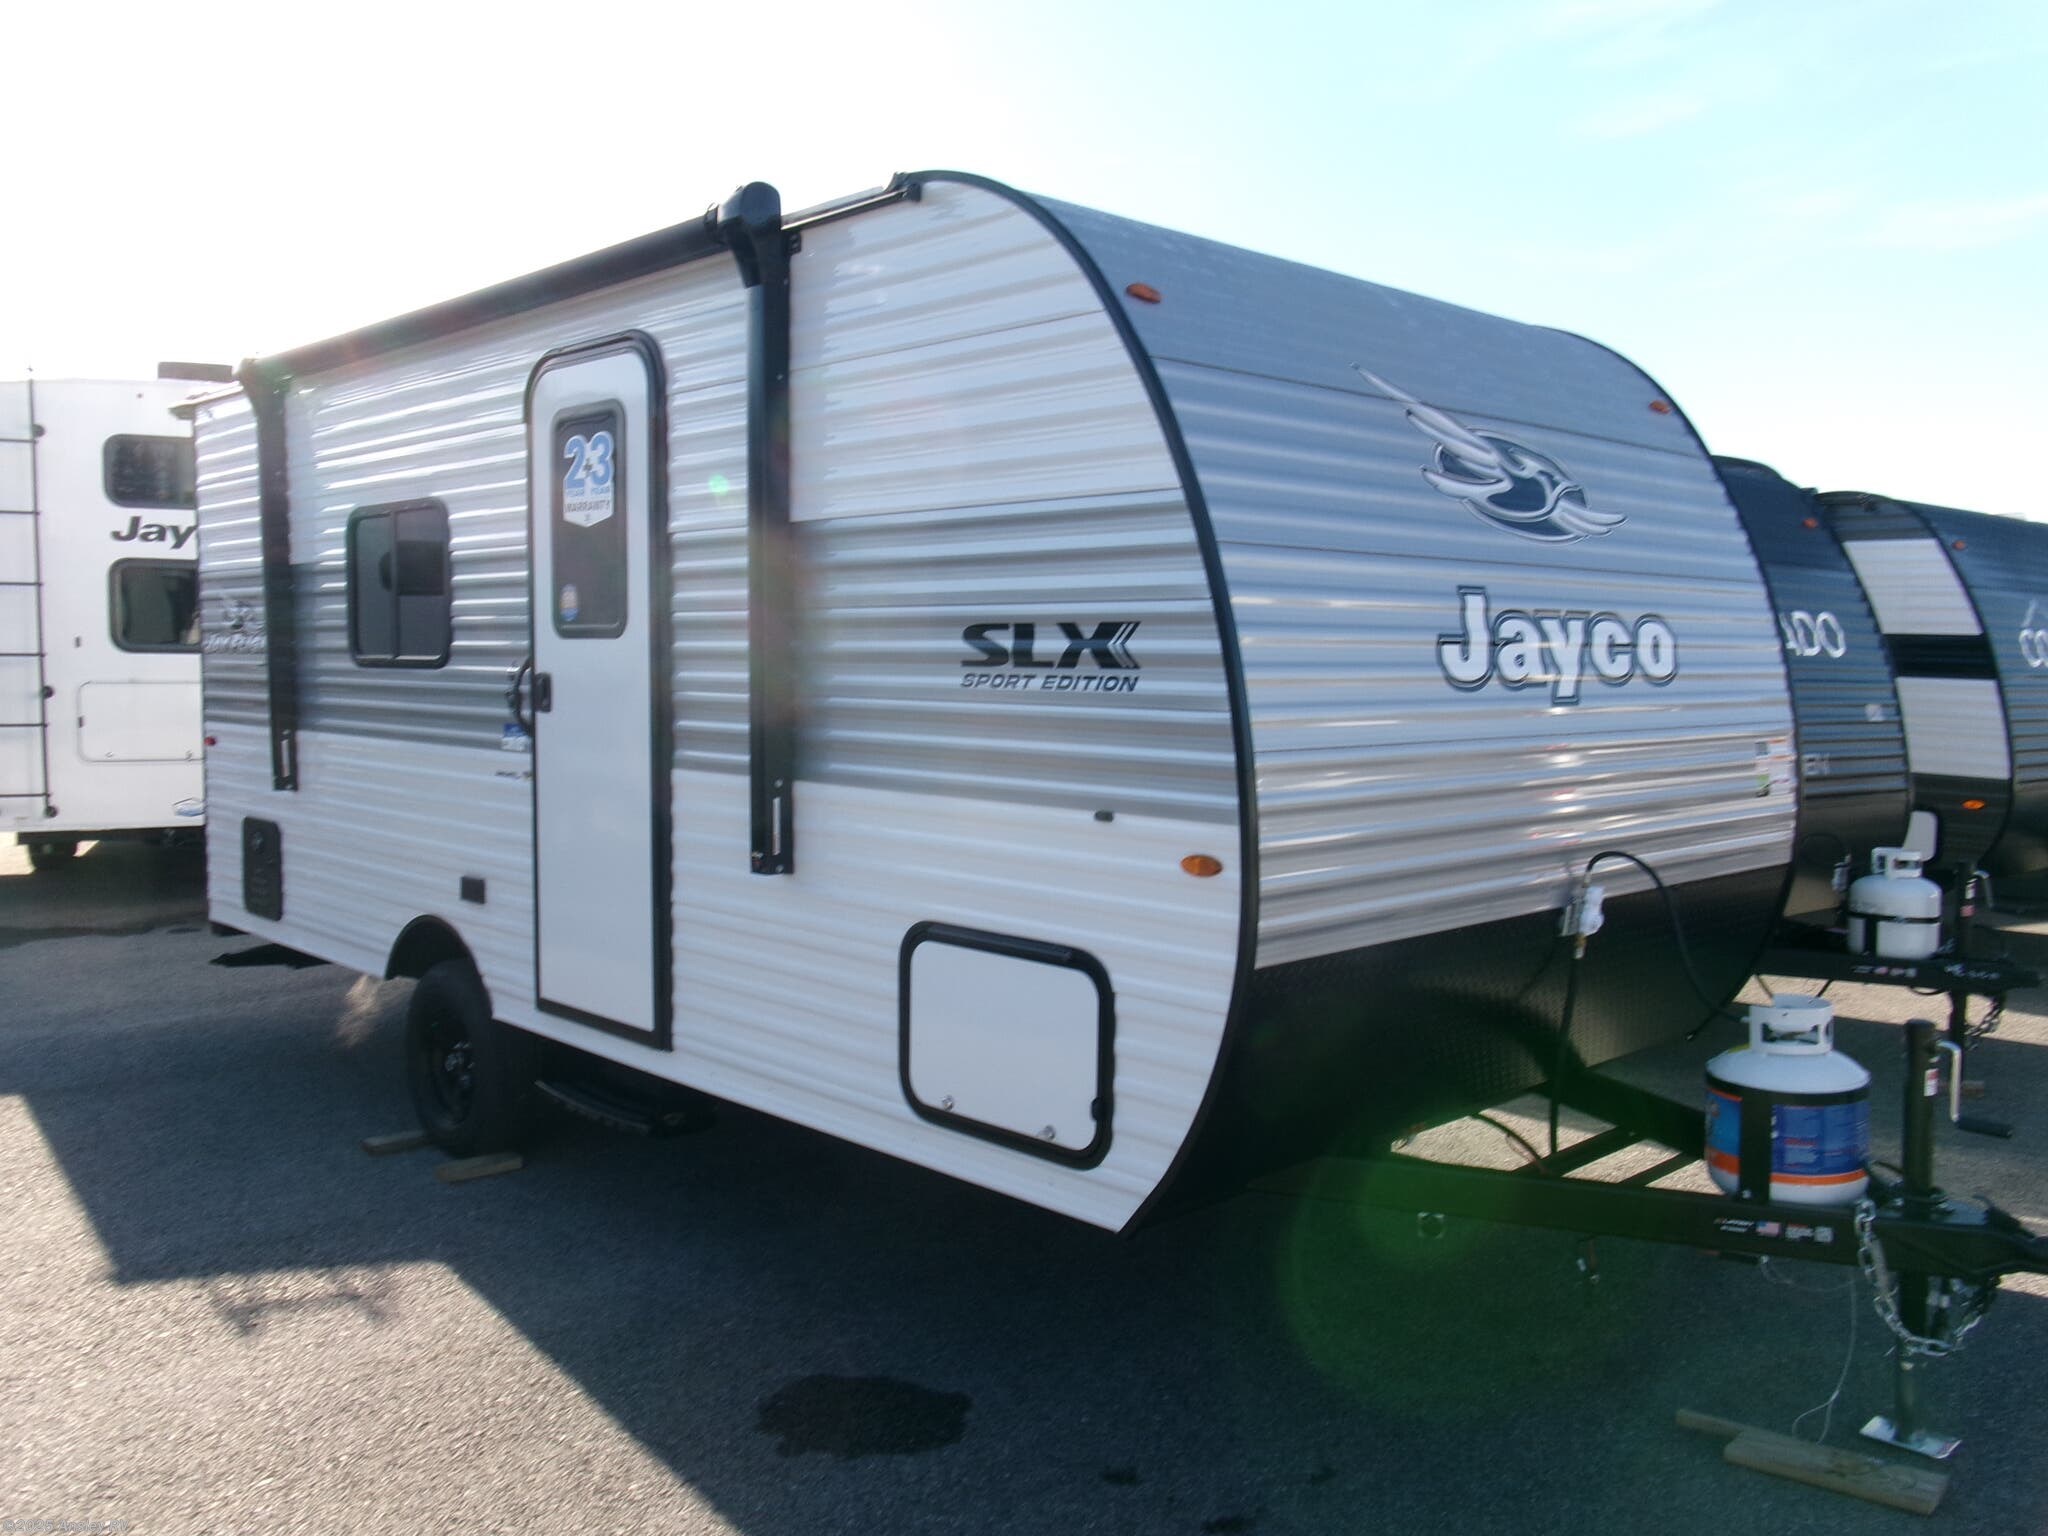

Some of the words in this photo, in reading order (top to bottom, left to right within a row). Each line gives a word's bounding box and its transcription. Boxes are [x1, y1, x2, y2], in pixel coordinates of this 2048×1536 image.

[111, 516, 198, 549] Jay
[961, 621, 1132, 669] SLX
[1437, 586, 1677, 705] Jayco
[961, 673, 1036, 689] SPORT
[1041, 675, 1140, 692] EDITION
